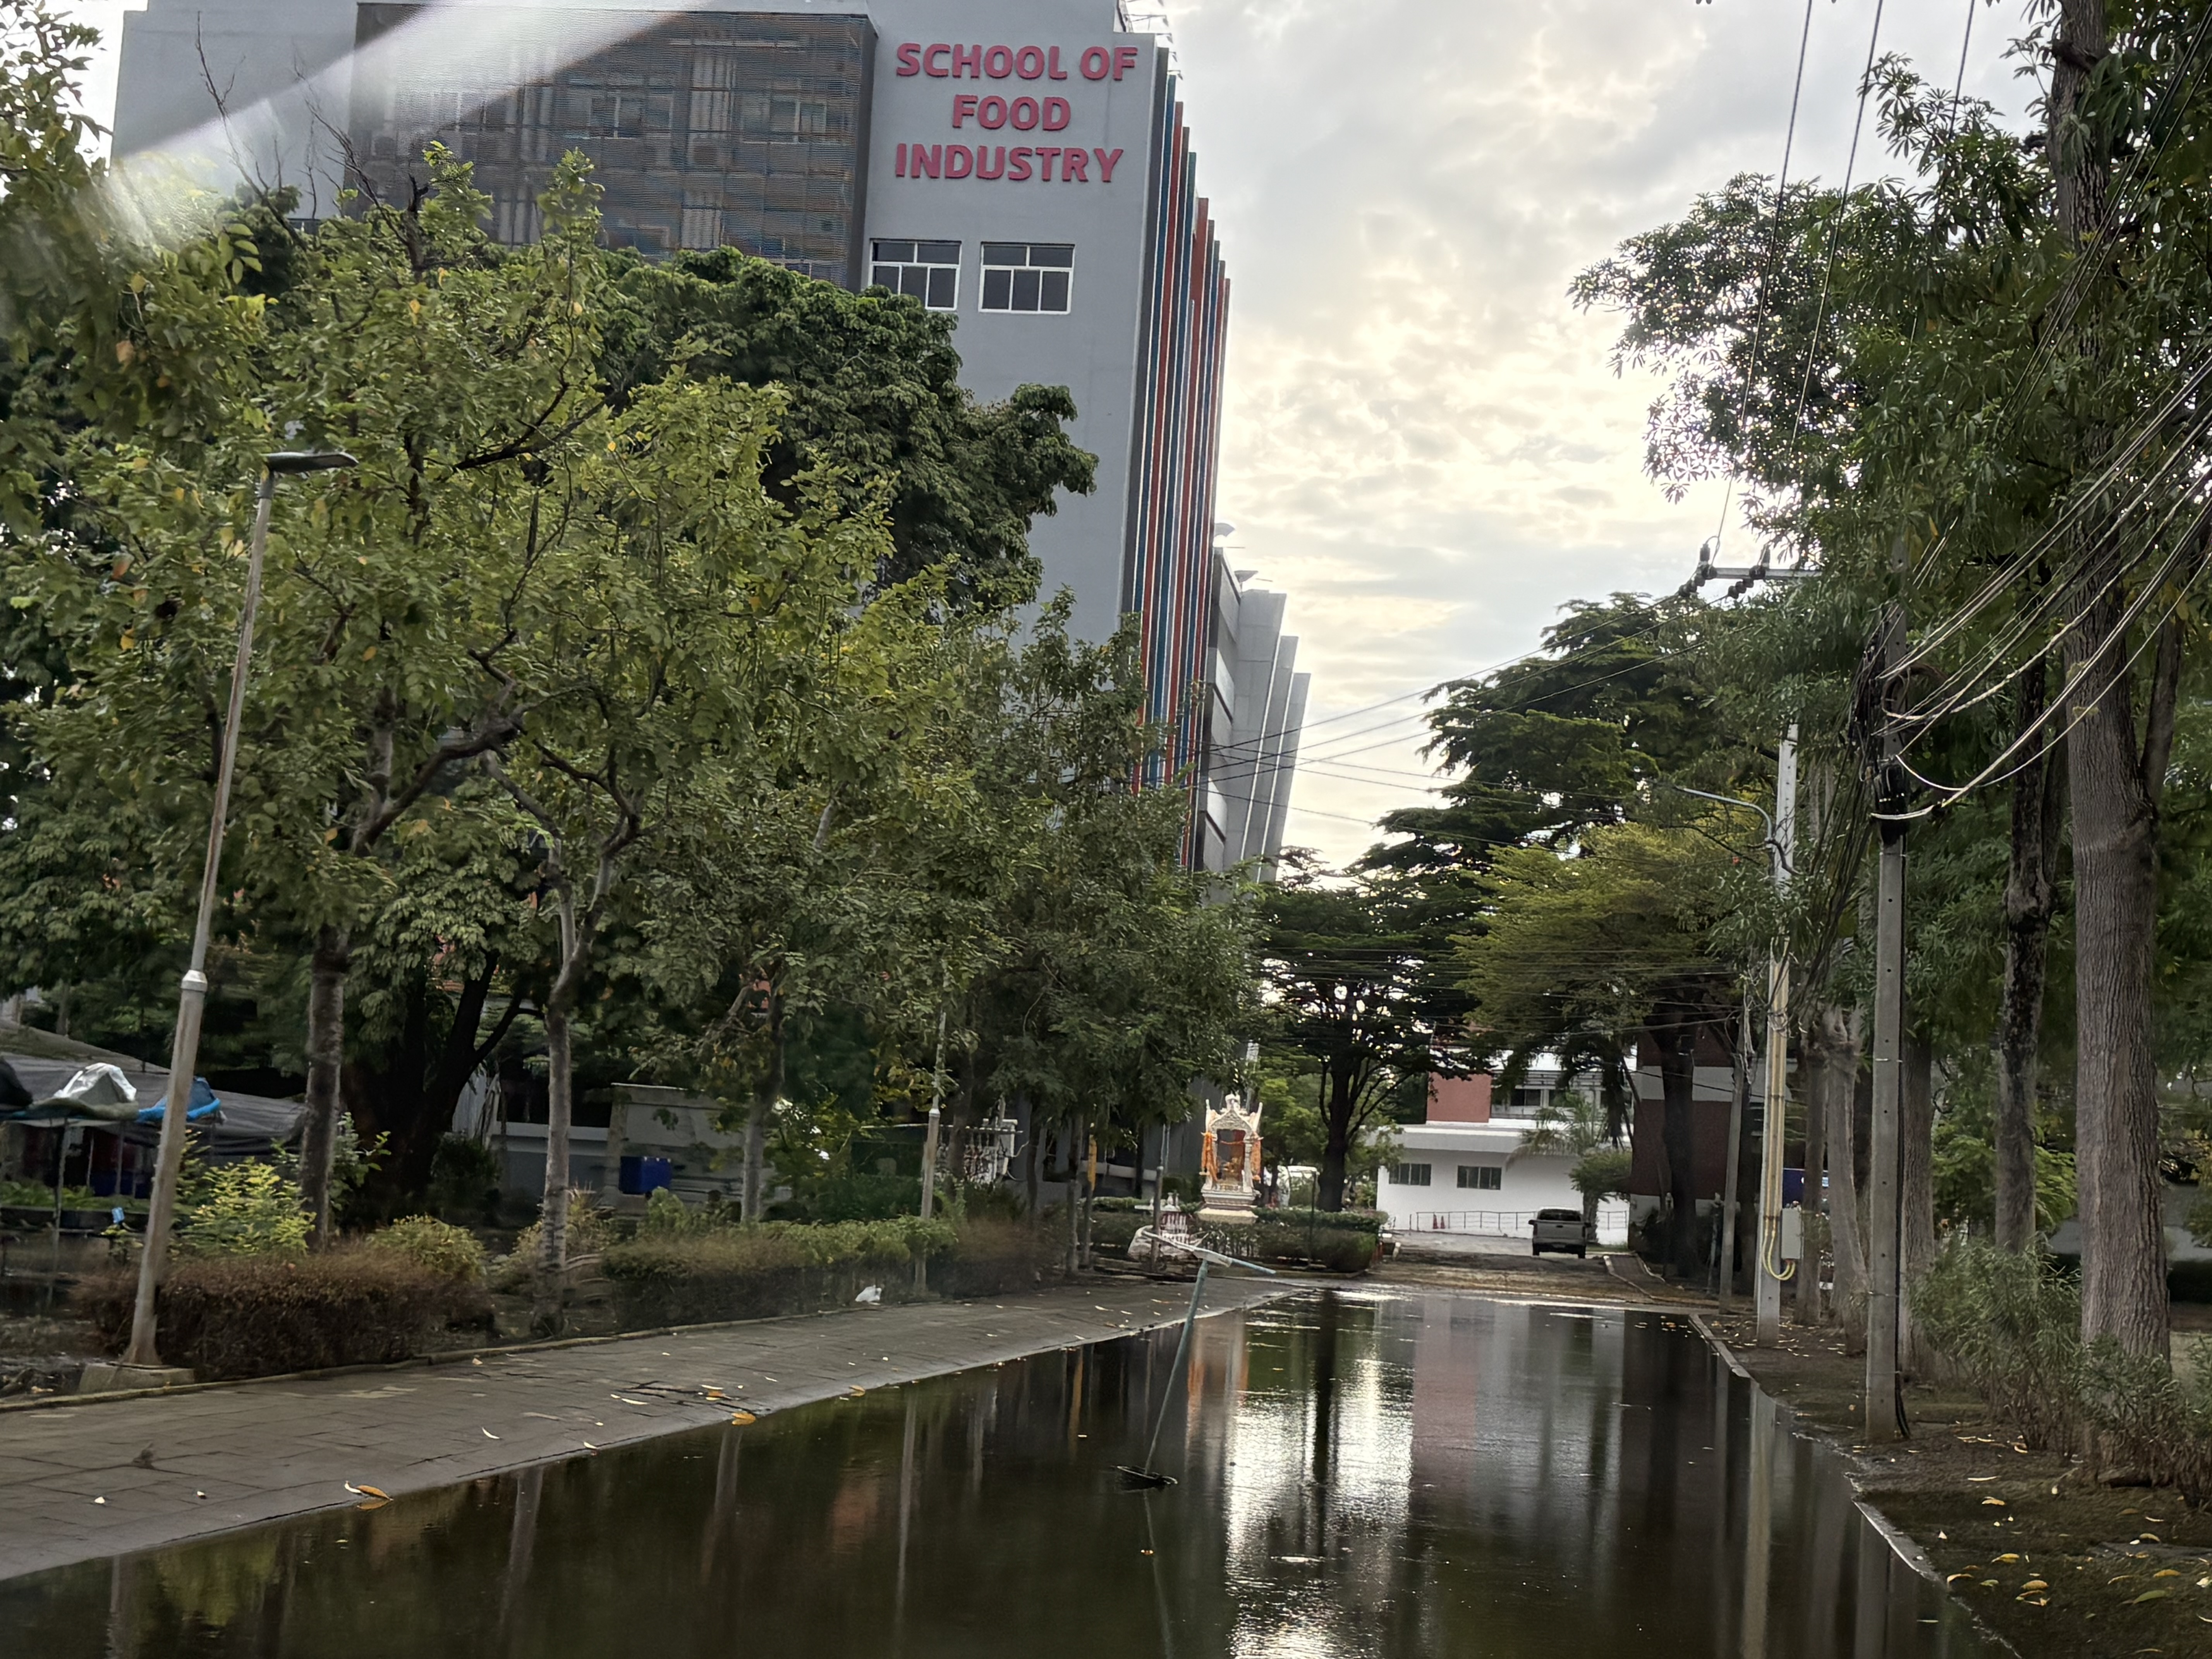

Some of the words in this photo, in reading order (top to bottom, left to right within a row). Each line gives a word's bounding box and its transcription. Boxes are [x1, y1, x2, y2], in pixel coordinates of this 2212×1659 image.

[896, 43, 1067, 79] SCHOOL
[1080, 46, 1138, 80] OF
[952, 94, 1071, 131] FOOD
[895, 143, 1123, 182] INDUSTRY
